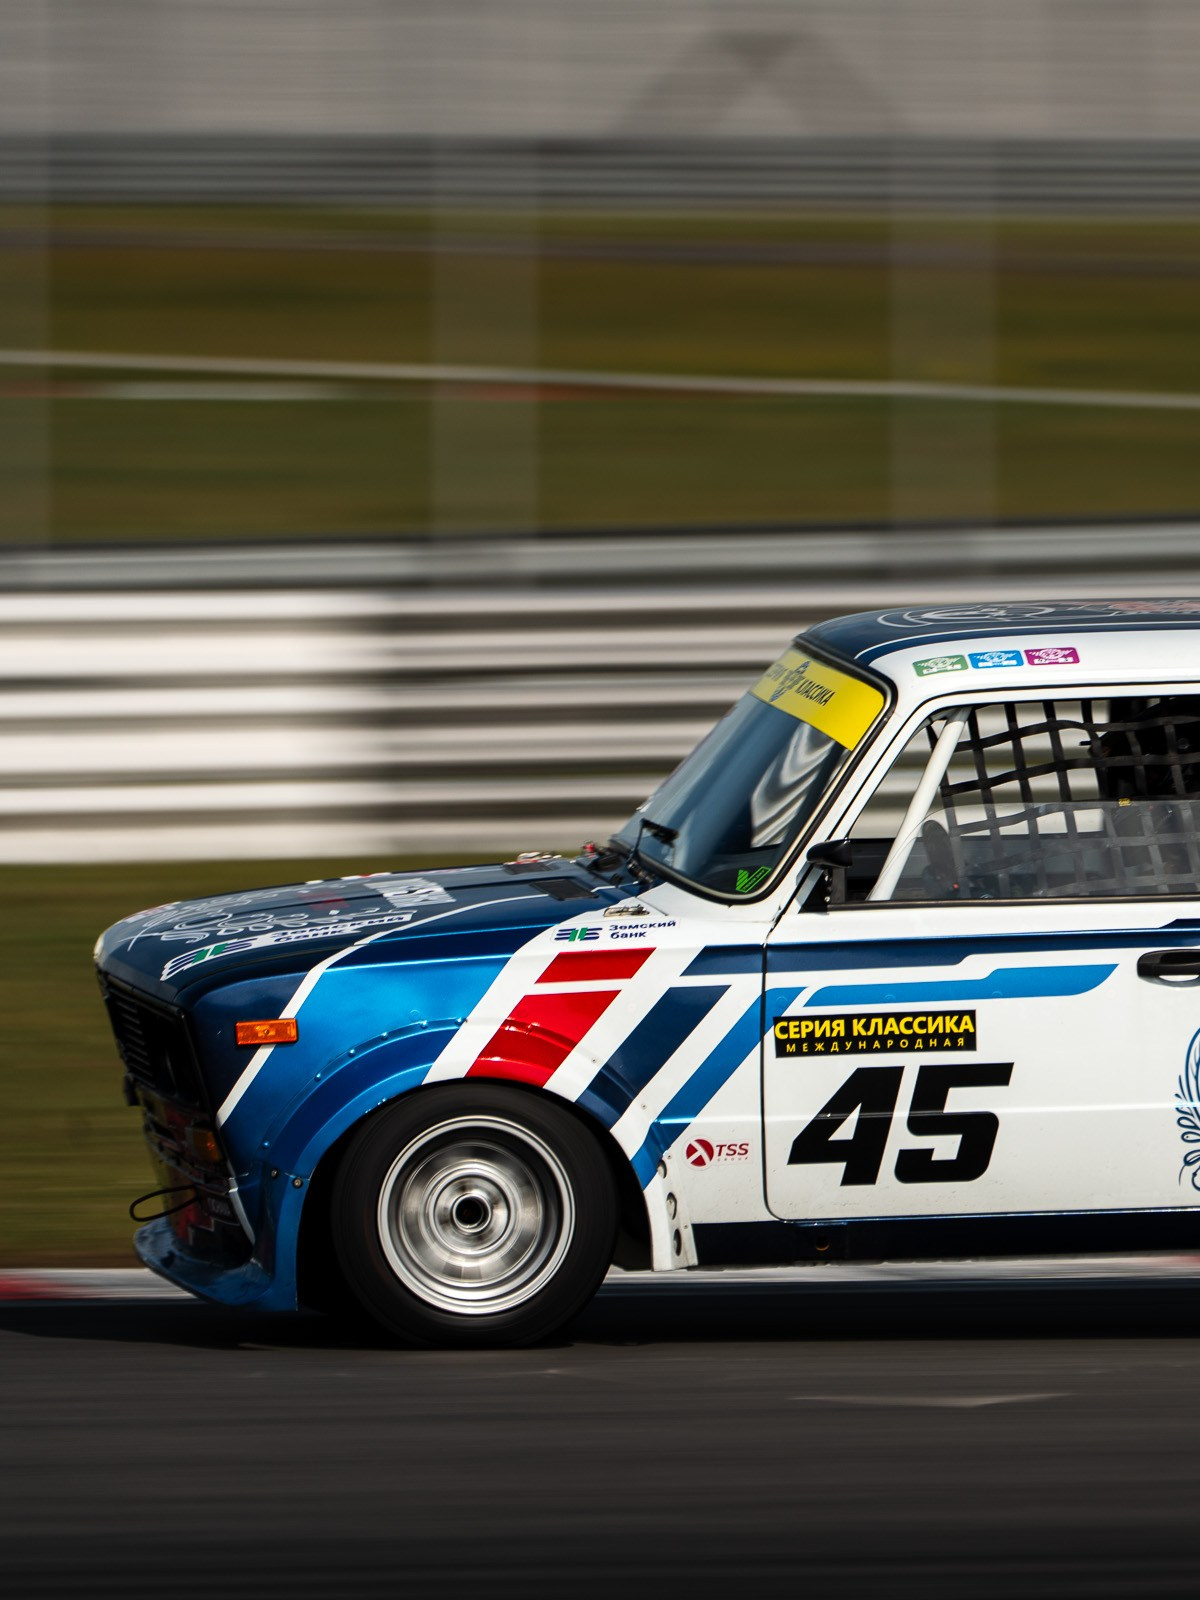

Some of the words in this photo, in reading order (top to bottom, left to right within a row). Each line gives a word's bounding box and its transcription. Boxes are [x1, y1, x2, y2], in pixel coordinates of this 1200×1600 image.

[609, 920, 677, 931] Земский
[610, 931, 647, 940] банк
[774, 1019, 846, 1040] СЕРИЯ
[852, 1015, 975, 1037] КЛАССИКА
[786, 1037, 965, 1053] МЕЖДУНАРОДНАЯ
[787, 1062, 1015, 1187] 45
[715, 1143, 749, 1157] TSS
